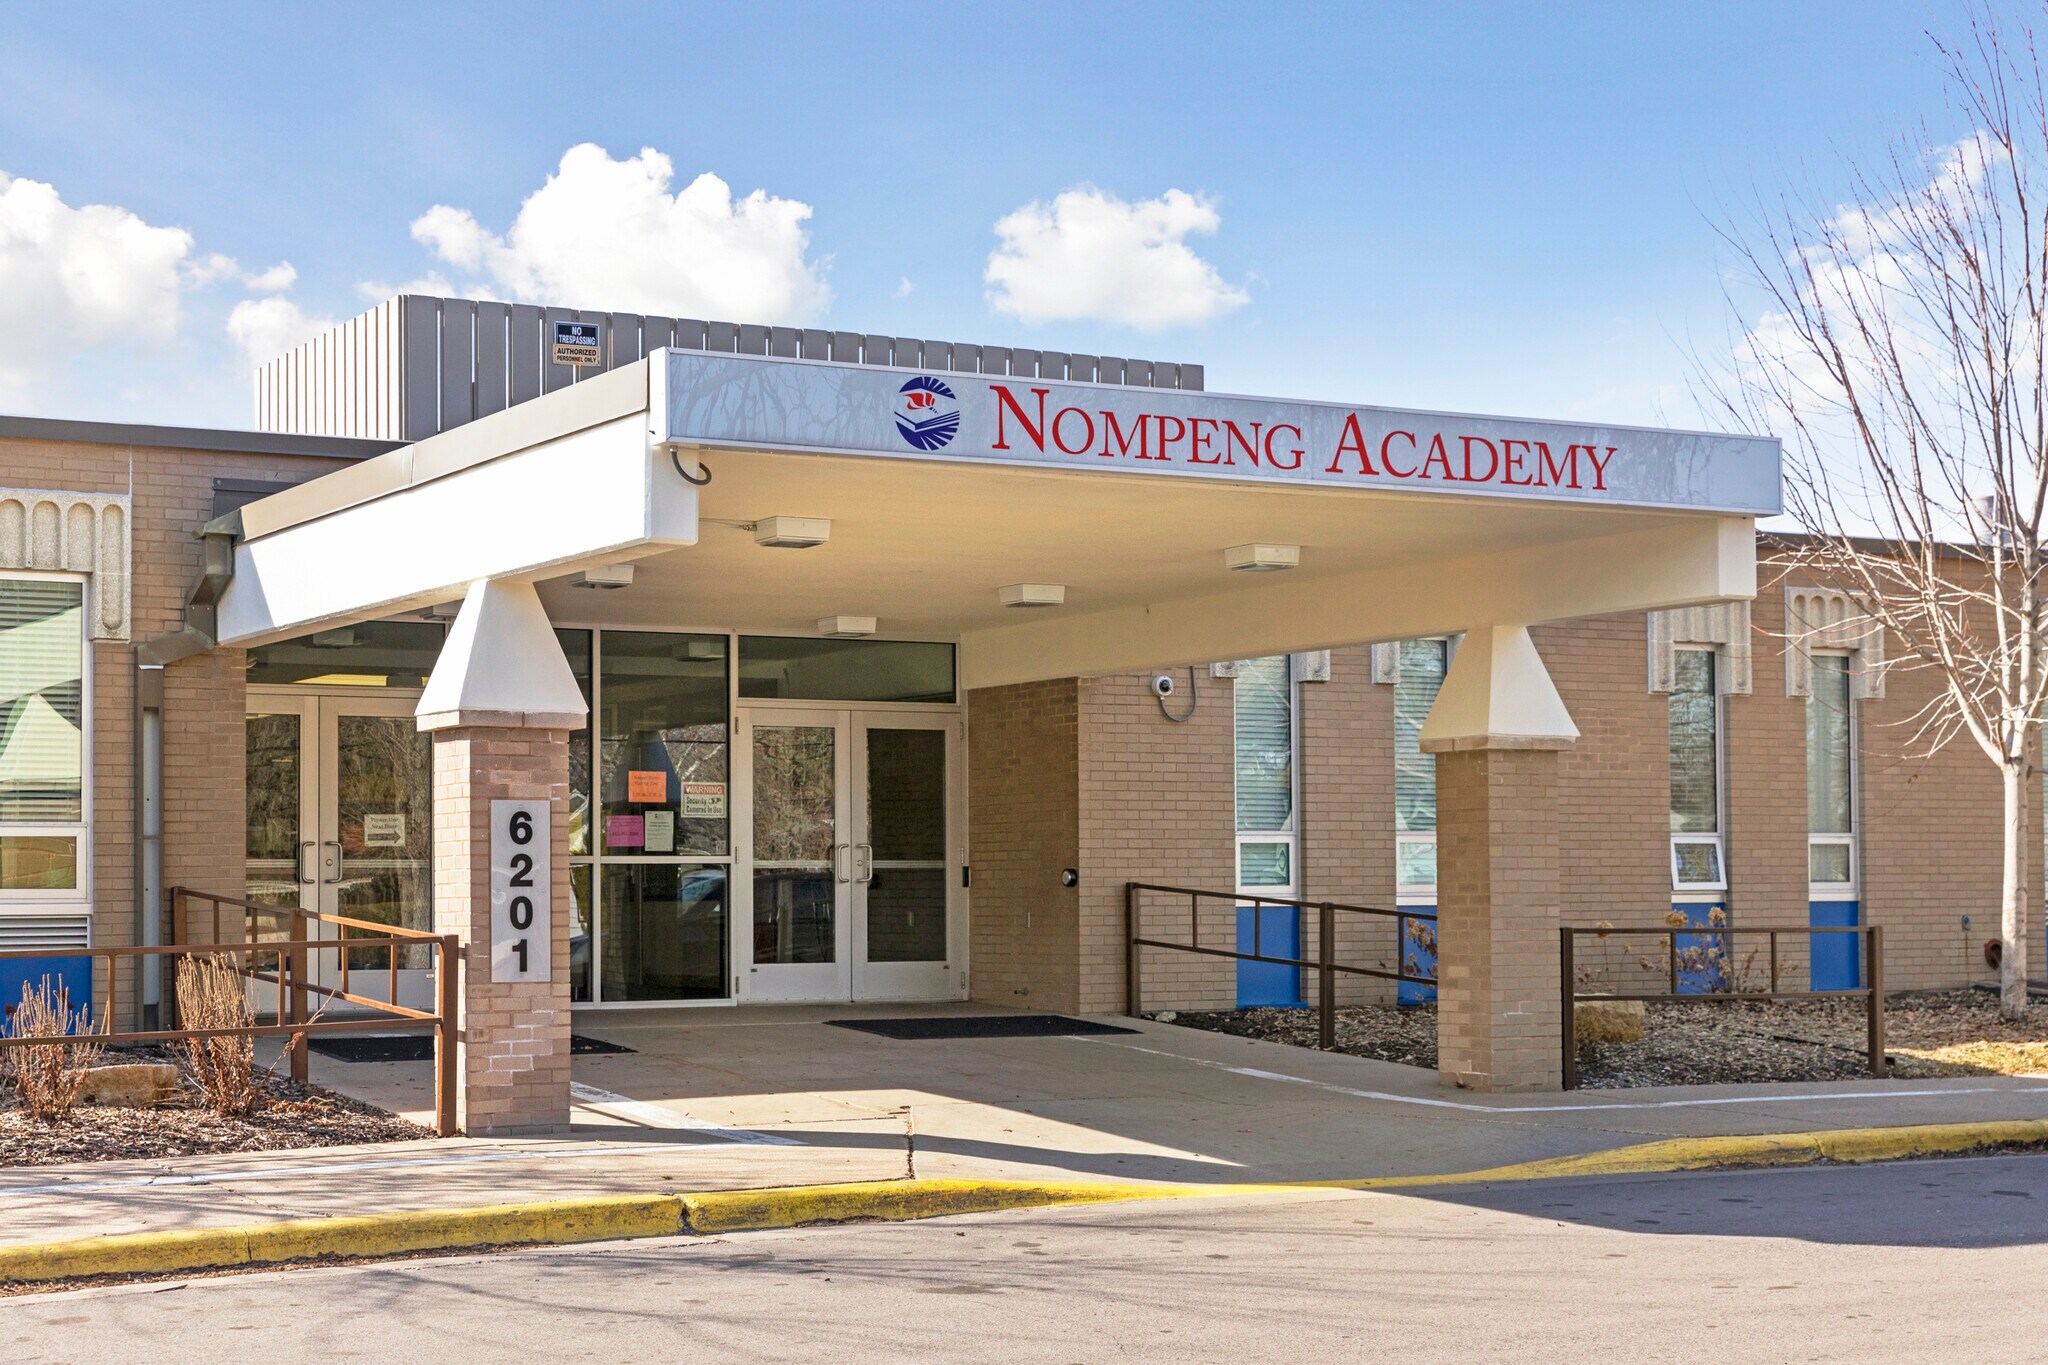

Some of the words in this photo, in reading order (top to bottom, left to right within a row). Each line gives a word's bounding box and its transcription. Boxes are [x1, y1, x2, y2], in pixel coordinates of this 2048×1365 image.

[571, 326, 582, 335] NO
[559, 335, 596, 345] TRESPASSING
[557, 347, 597, 356] AUTHORIZED
[989, 385, 1306, 472] NOMPENG
[1325, 411, 1618, 491] ACADEMY
[685, 785, 723, 794] WARNING
[686, 797, 707, 805] Security
[509, 811, 534, 972] 6201
